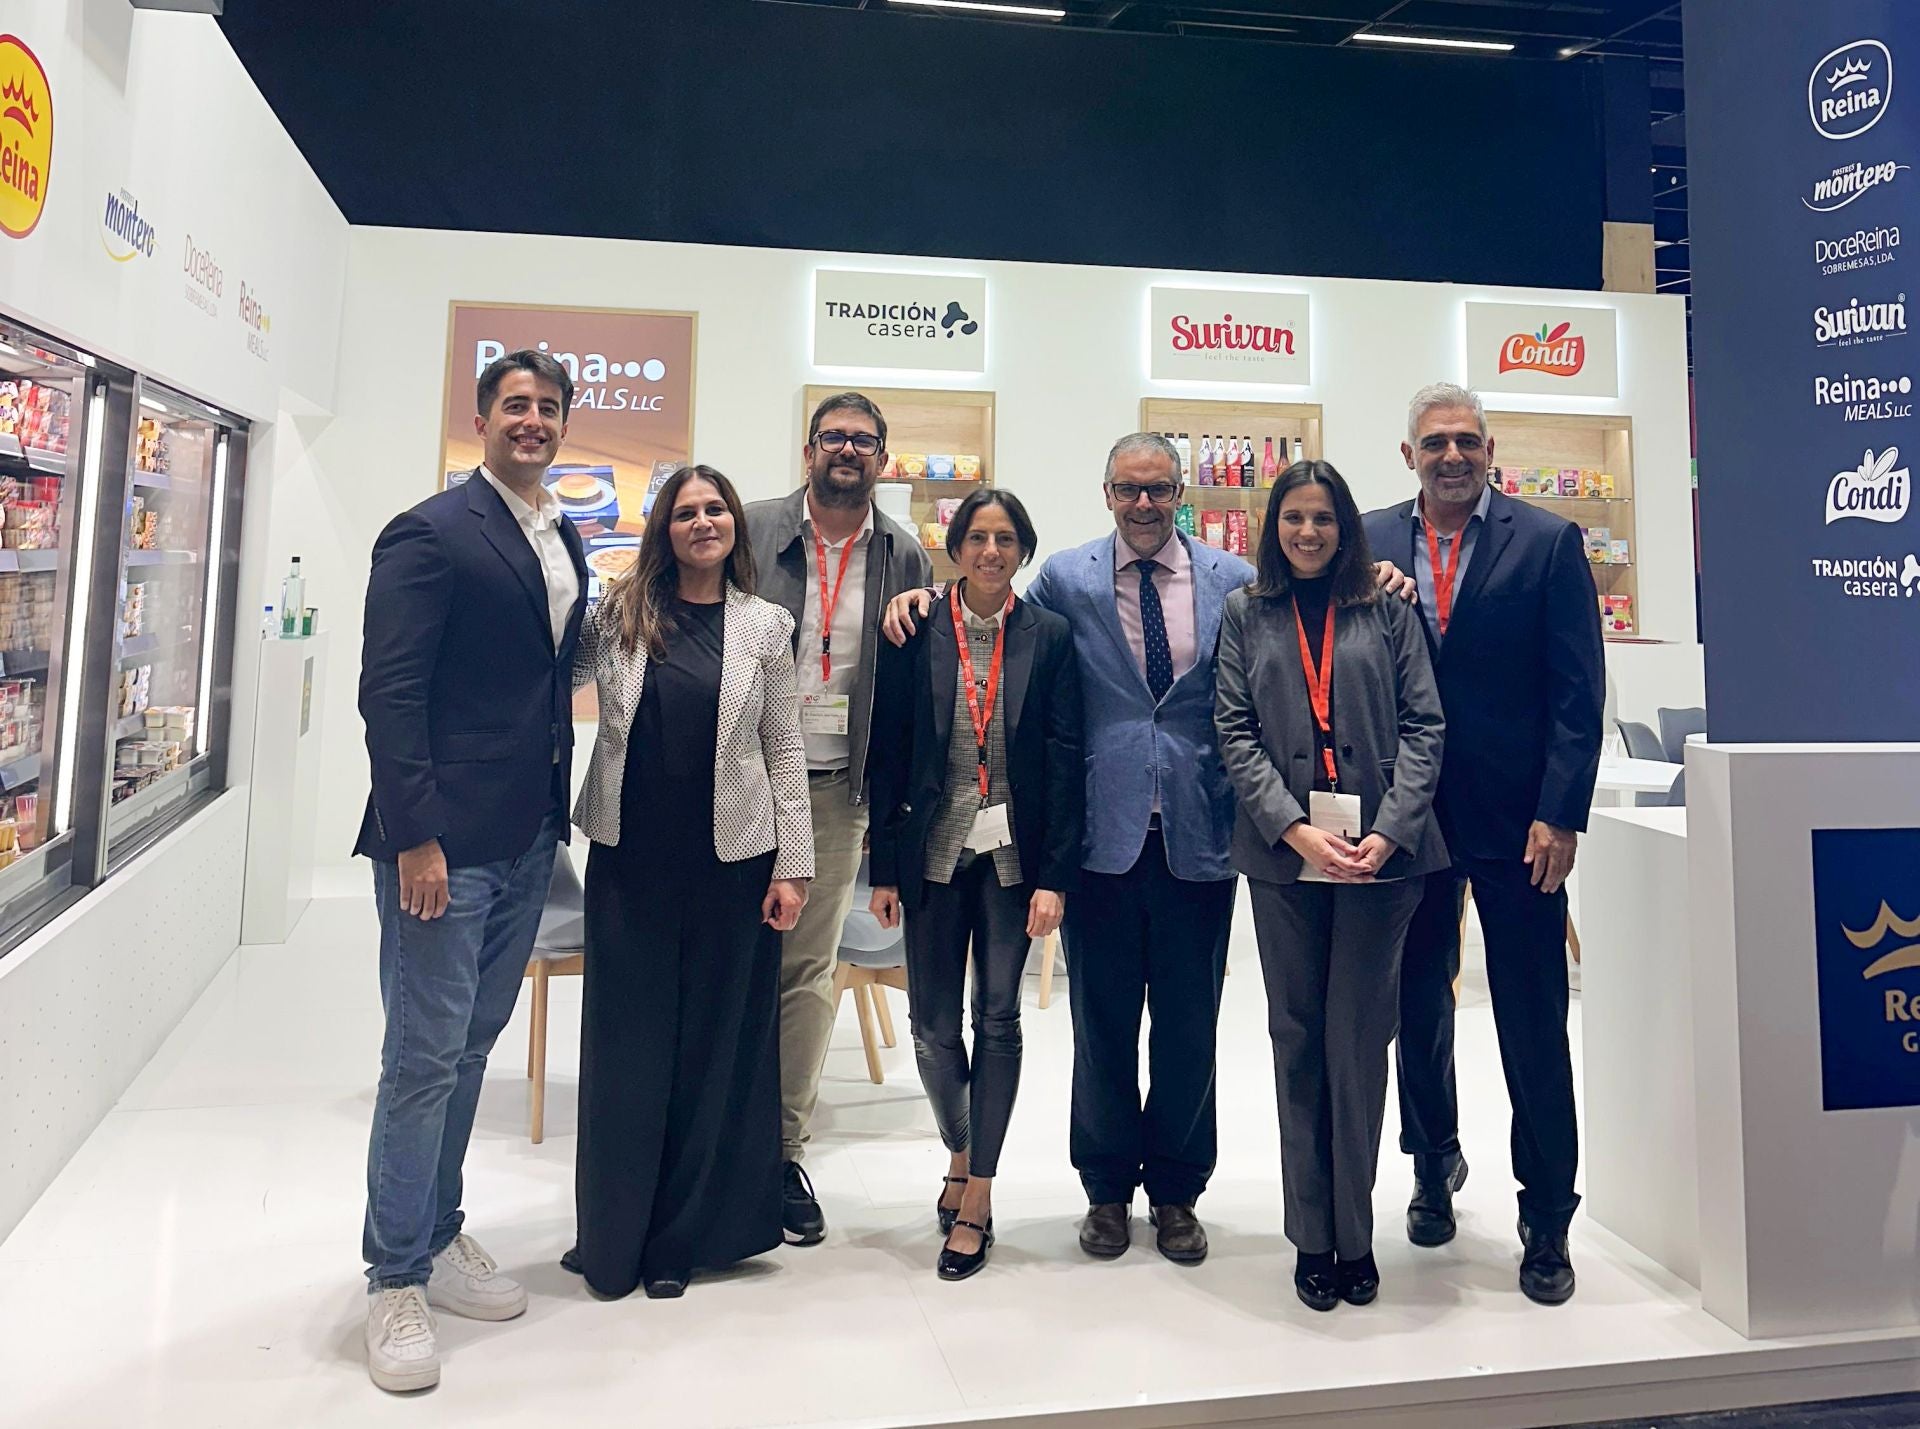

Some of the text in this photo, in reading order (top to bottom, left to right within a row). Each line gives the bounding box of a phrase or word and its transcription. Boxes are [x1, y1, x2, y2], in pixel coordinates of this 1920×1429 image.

[1821, 87, 1880, 122] Reina
[0, 131, 39, 202] eina
[1813, 161, 1896, 202] montero
[1832, 163, 1855, 177] POSTRES
[105, 192, 154, 258] montero
[1815, 226, 1900, 264] DoceReina
[239, 280, 262, 331] Reina
[825, 302, 937, 322] TRADICIÓN
[1814, 298, 1906, 342] Surivan
[867, 323, 936, 338] casera
[1171, 313, 1295, 355] Surivan
[1839, 335, 1883, 347] feel the taste
[475, 340, 607, 382] Rna
[1506, 337, 1578, 366] Condi
[569, 387, 665, 412] EALS LLC
[1815, 374, 1881, 405] Reina
[1844, 401, 1912, 422] MEALS LLC
[1832, 476, 1902, 511] Condi
[1812, 556, 1898, 579] TRADICIÓN
[1843, 580, 1898, 598] casera
